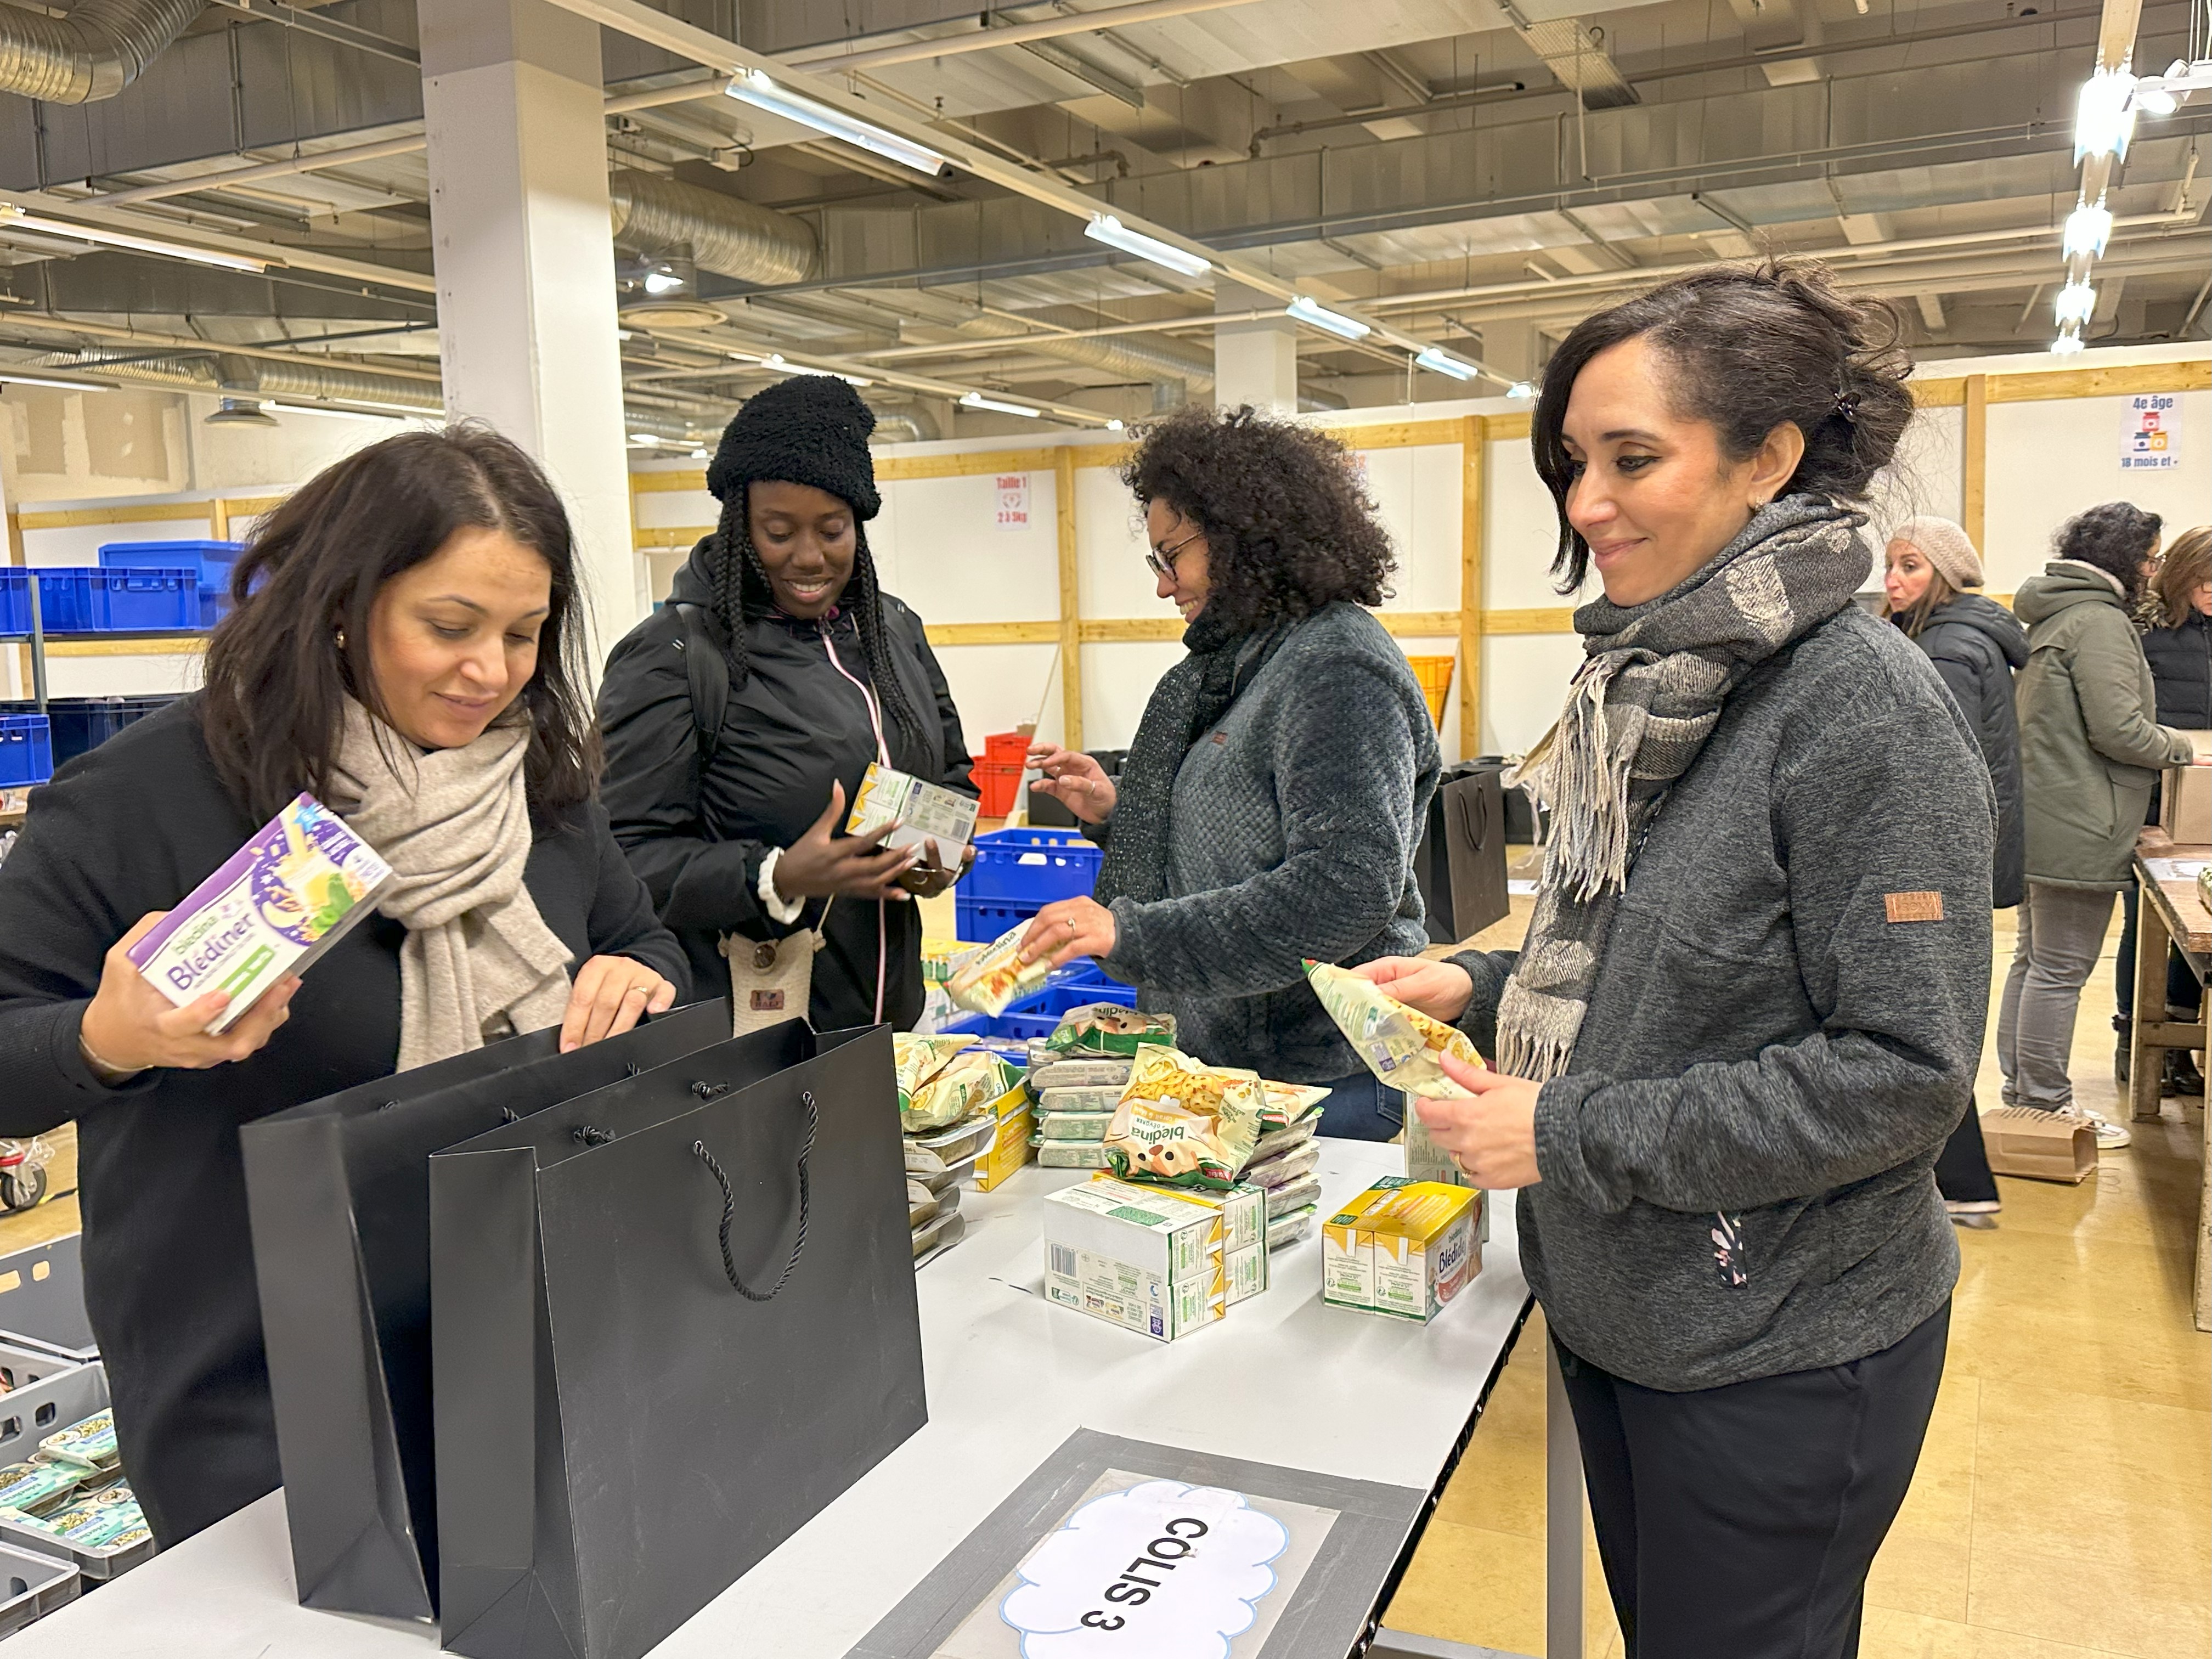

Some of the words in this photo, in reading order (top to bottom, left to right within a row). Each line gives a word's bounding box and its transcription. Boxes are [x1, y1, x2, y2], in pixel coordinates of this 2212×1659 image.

[2133, 398, 2148, 409] 4e
[2151, 396, 2173, 410] âge
[2121, 458, 2131, 467] 18
[2134, 456, 2158, 467] mois
[2161, 456, 2171, 466] et
[1104, 1517, 1208, 1606] COLIS
[1080, 1611, 1125, 1631] 3
